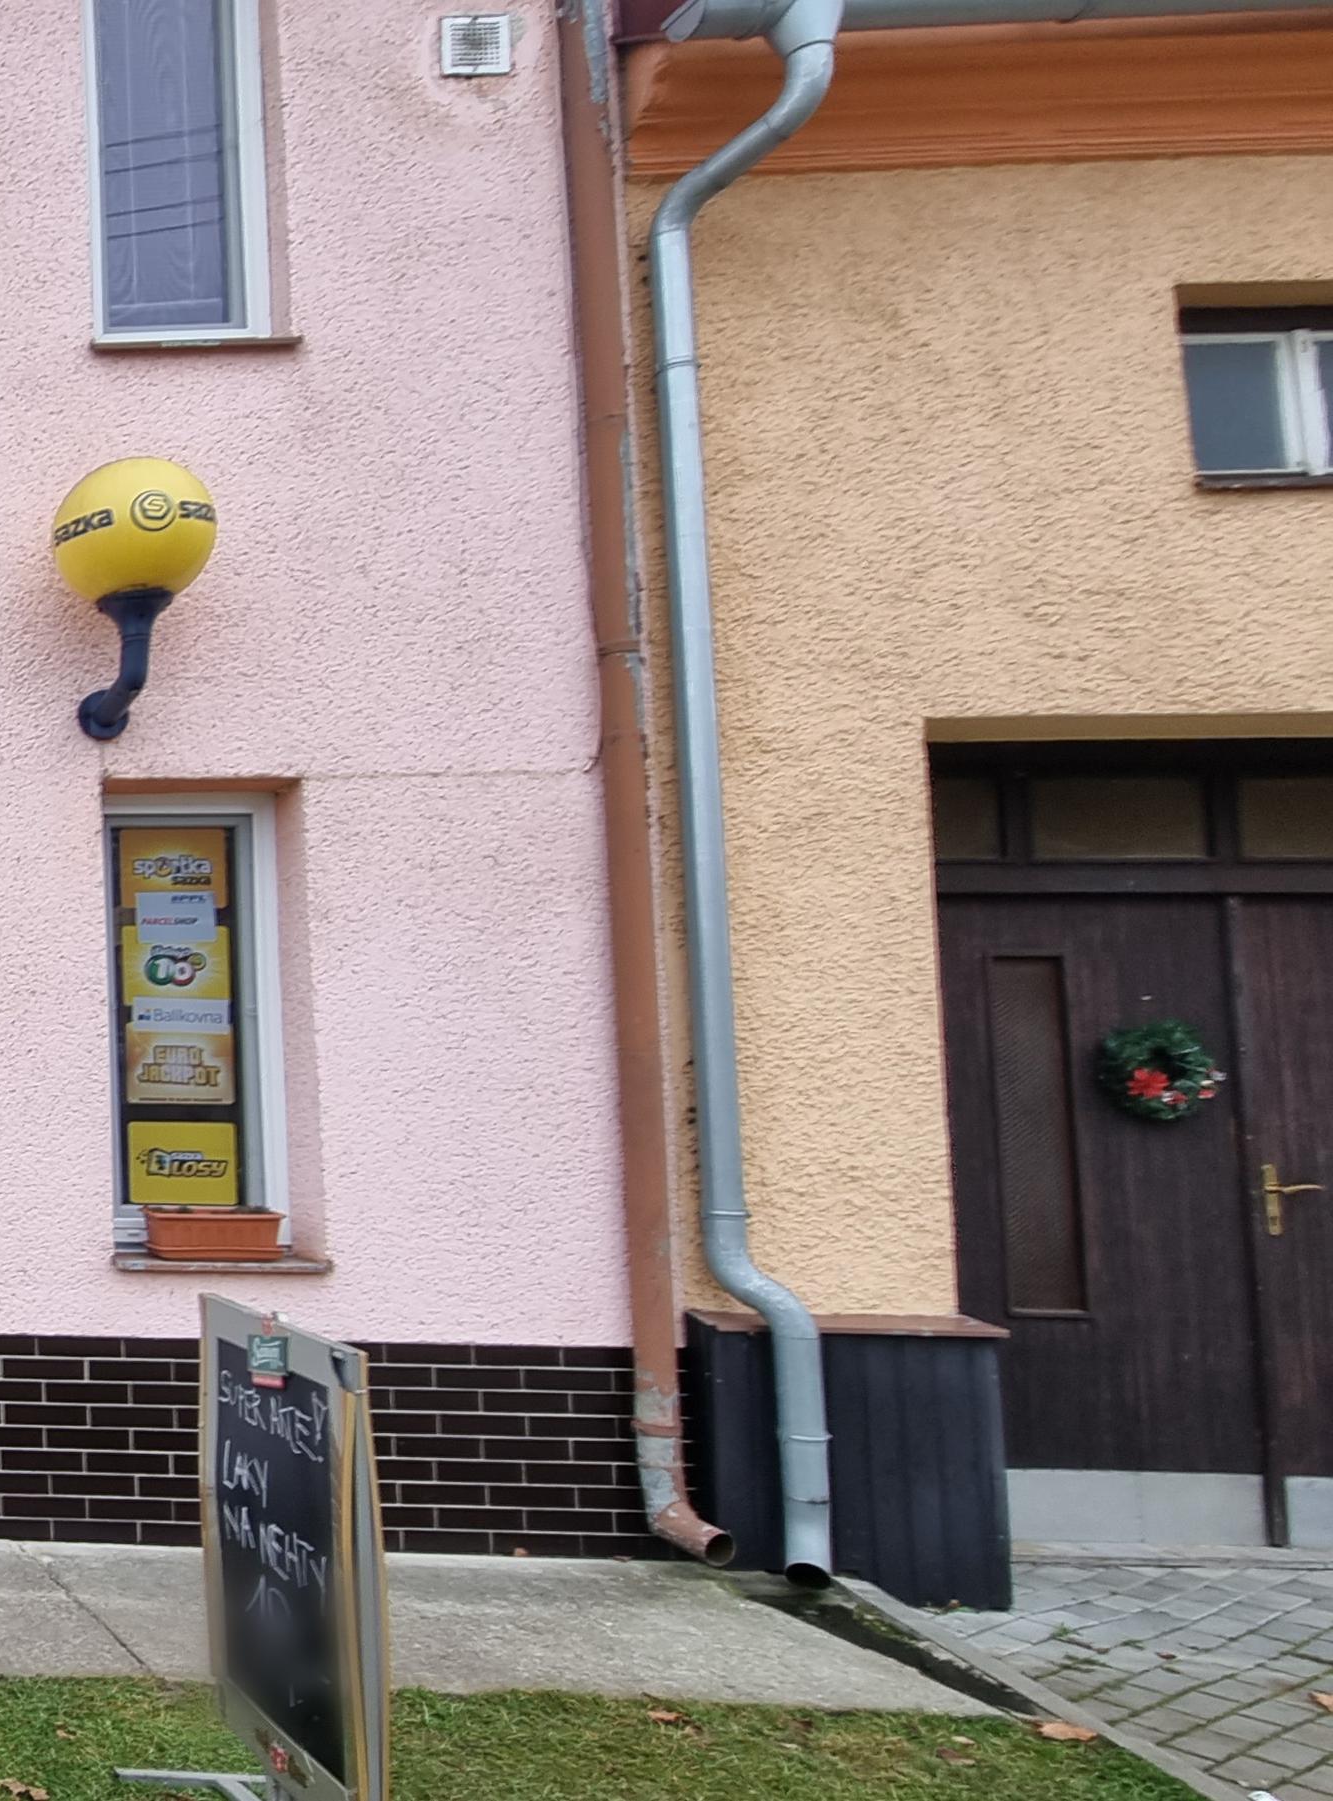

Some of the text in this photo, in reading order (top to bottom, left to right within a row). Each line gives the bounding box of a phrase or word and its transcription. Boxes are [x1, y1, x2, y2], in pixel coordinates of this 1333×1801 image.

[154, 1045, 203, 1066] EURO
[137, 1063, 220, 1087] JACKPOT
[171, 1159, 228, 1177] LOSY
[223, 1501, 256, 1551] NA
